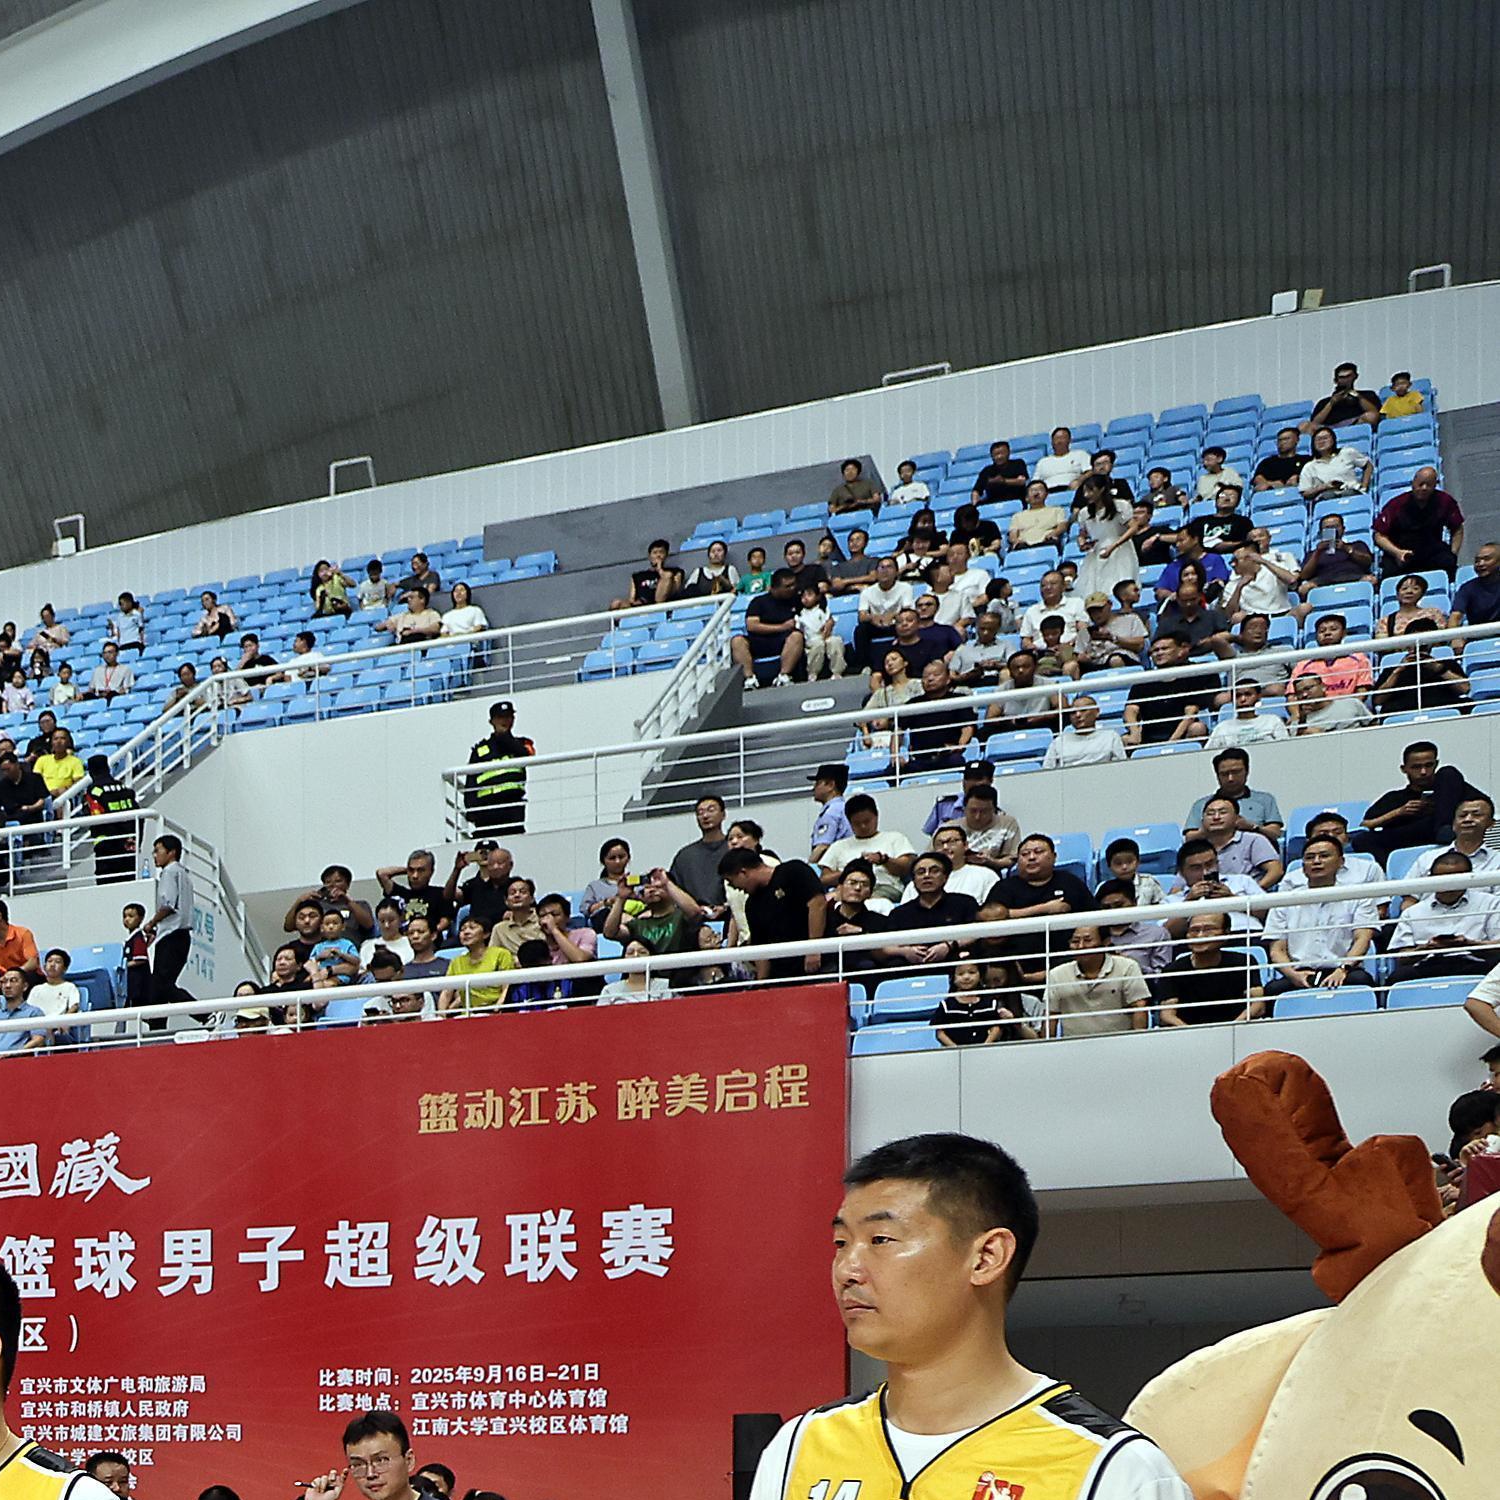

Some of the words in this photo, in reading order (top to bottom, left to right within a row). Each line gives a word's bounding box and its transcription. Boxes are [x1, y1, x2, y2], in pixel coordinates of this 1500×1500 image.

[417, 1081, 598, 1134] 篮动江苏
[616, 1064, 810, 1121] 醉美启程
[20, 1375, 206, 1395] 宜兴市文体广电和旅游局
[20, 1399, 189, 1419] 宜兴市和桥镇人民政府
[20, 1423, 243, 1442] 宜兴市城建文旅集团有限公司
[412, 1413, 629, 1436] 江南大学宜兴校区体育馆
